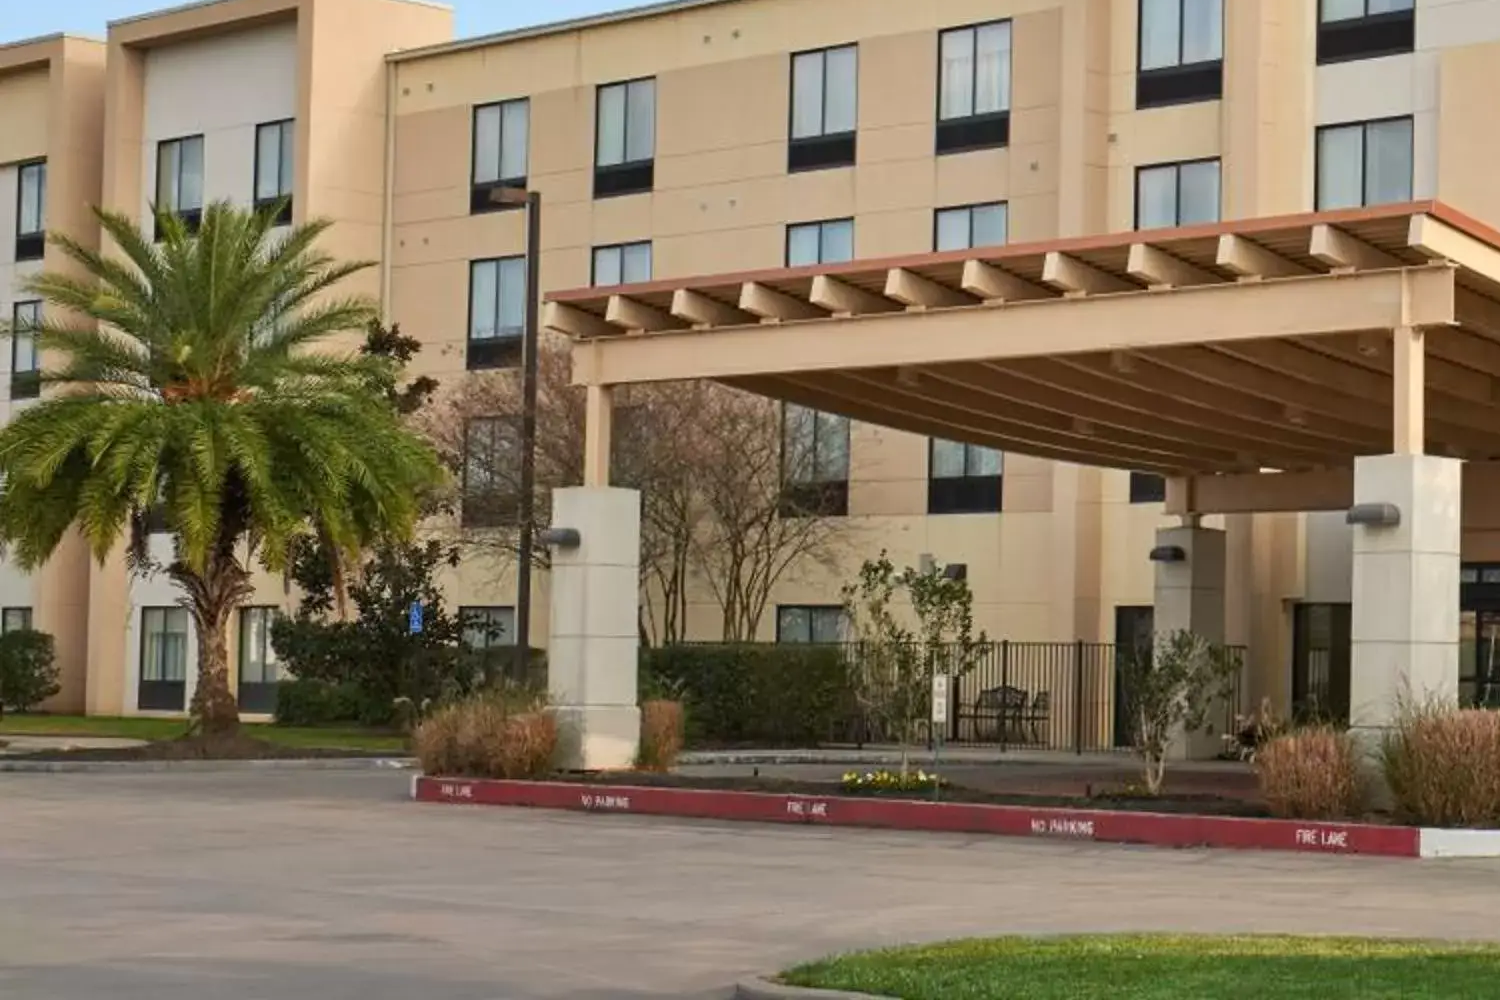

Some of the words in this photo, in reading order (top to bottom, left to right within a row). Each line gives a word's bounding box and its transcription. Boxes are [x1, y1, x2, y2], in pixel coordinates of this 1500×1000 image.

[1030, 818, 1046, 832] NO
[1049, 819, 1094, 835] PARKING
[1295, 829, 1317, 845] FIRE
[1321, 831, 1348, 847] LANE
